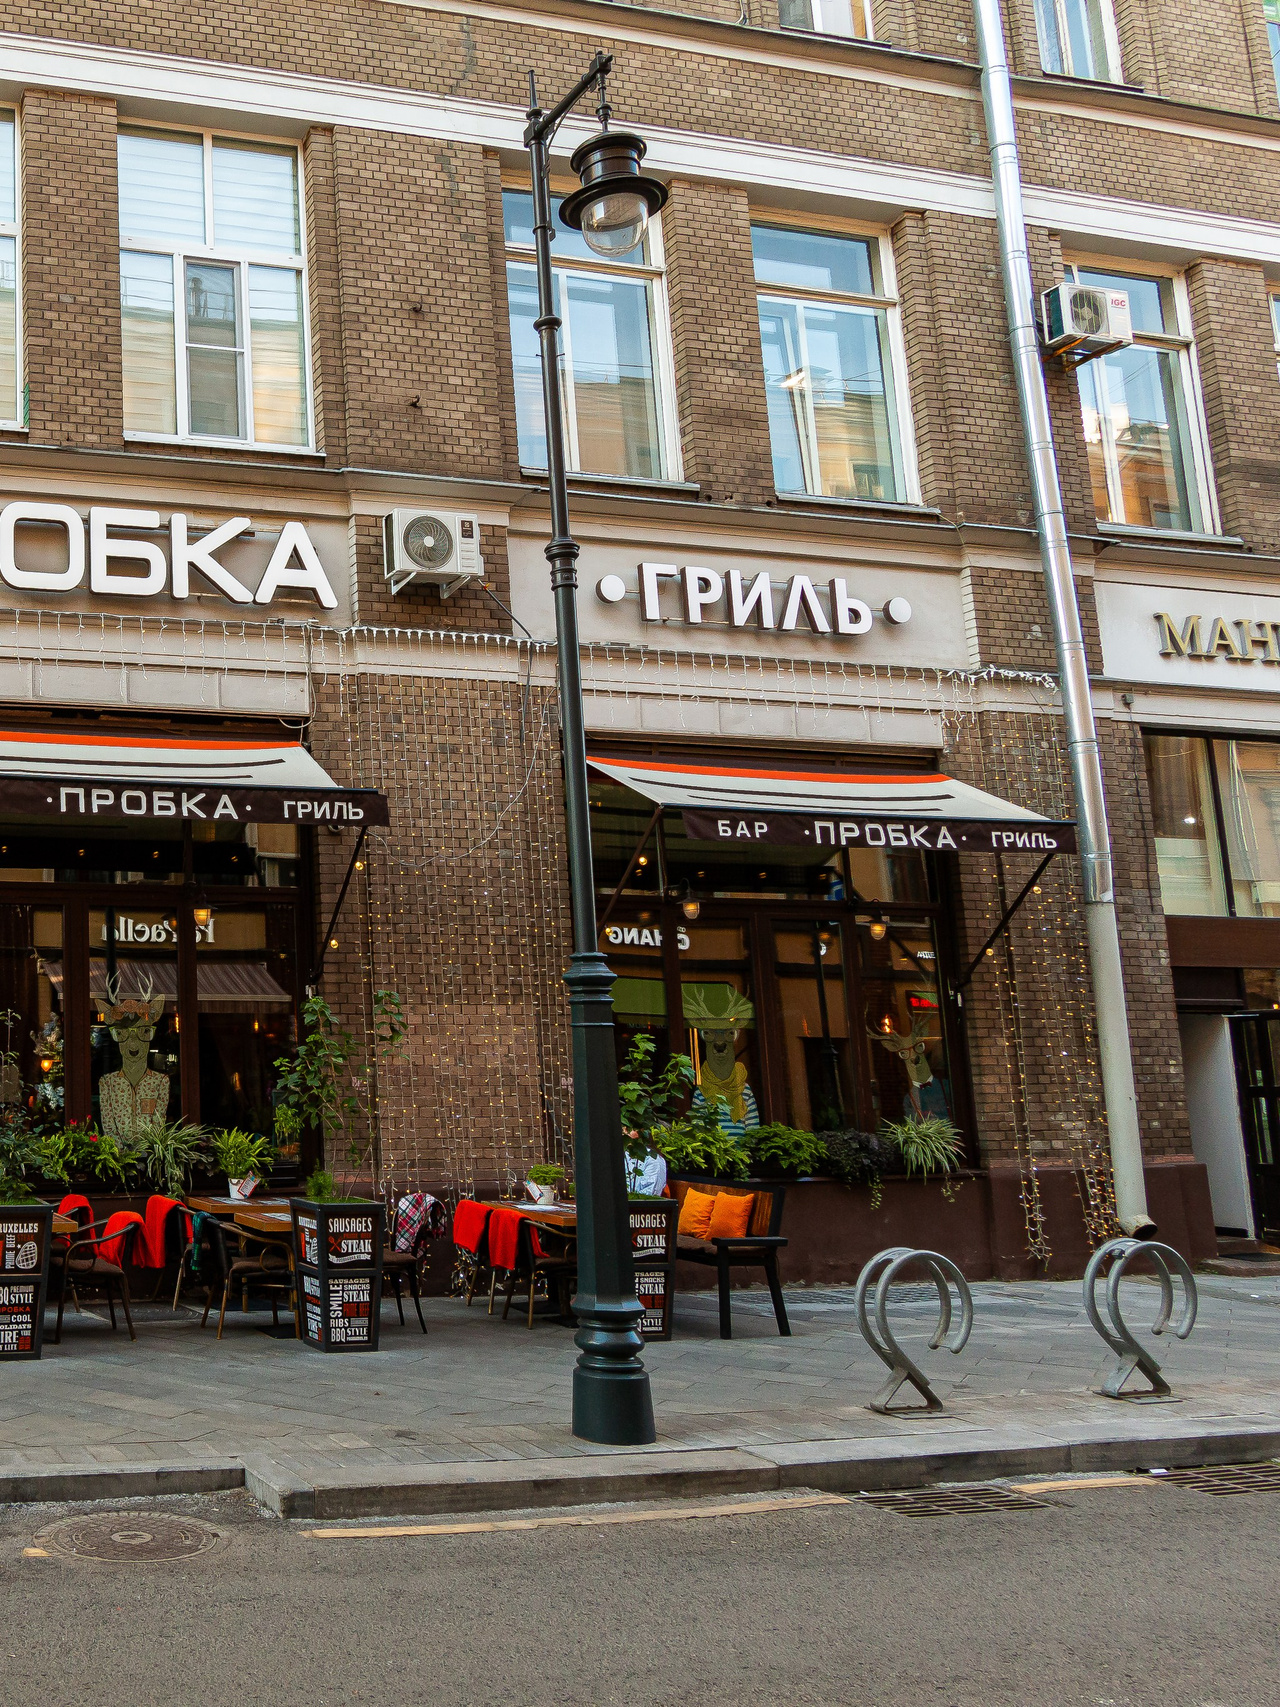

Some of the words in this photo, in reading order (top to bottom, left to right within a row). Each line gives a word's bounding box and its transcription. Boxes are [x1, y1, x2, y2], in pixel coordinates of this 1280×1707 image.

[1111, 298, 1126, 307] IGC
[637, 561, 874, 636] ГРИЛЬ
[1152, 611, 1280, 663] МАН
[59, 786, 240, 821] ПРОБКА
[283, 800, 365, 821] ГРИЛЬ
[717, 818, 769, 838] БАР
[814, 820, 959, 850] ПРОБКА
[990, 830, 1058, 850] ГРИЛЬ
[328, 1217, 372, 1233] SAUSAGES
[629, 1213, 667, 1228] AUSAGES
[5, 1233, 16, 1248] BEEF
[341, 1239, 372, 1253] STEAK
[636, 1234, 667, 1248] STEAK
[343, 1283, 370, 1291] SNACKS
[639, 1283, 665, 1295] STEAK
[10, 1292, 34, 1305] STYLE
[329, 1284, 343, 1318] SMILE
[343, 1290, 370, 1303] STEAK
[11, 1314, 32, 1323] COOL
[330, 1318, 349, 1328] RIBS
[642, 1318, 663, 1327] STYLE
[330, 1328, 346, 1343] BBQ
[346, 1327, 368, 1336] STYLE
[4, 1343, 18, 1351] LIFE
